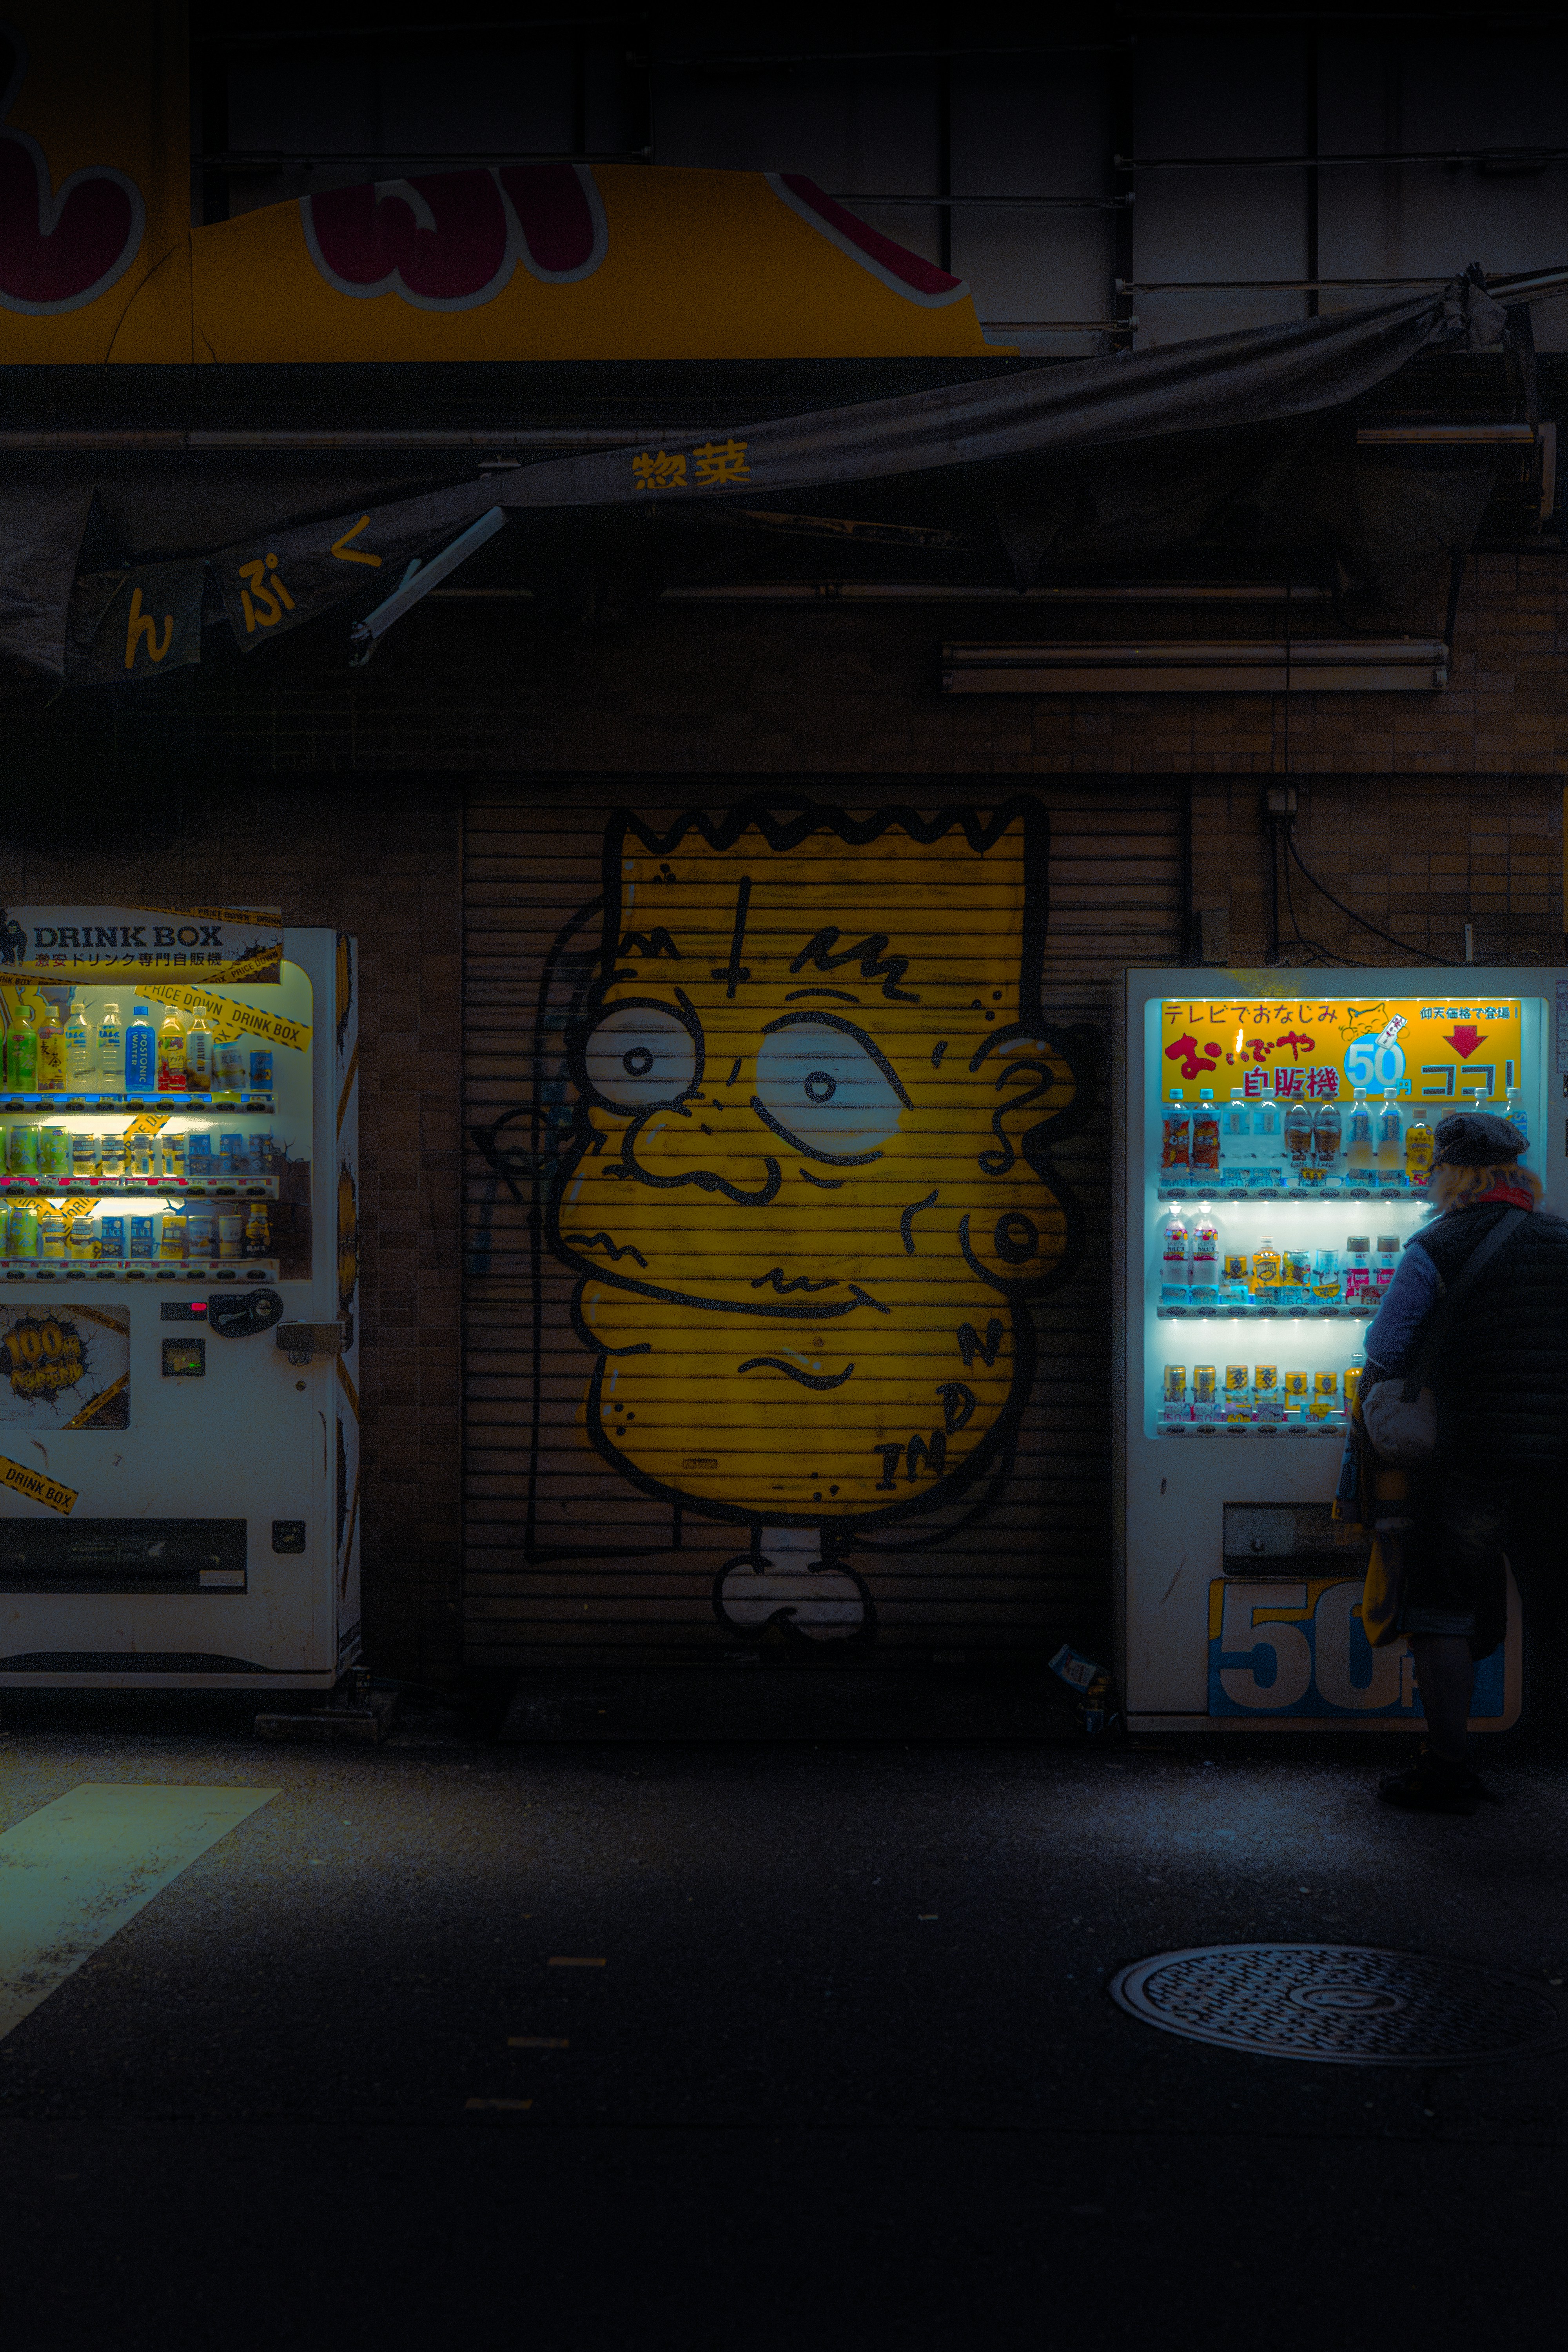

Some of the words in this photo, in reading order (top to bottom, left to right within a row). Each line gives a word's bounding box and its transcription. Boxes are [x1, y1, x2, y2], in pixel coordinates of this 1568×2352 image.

[632, 439, 751, 490] 惣菜
[34, 927, 147, 947] DRINK
[153, 926, 223, 947] BOX
[36, 953, 222, 967] 激安ドリンク専門自販機
[231, 963, 254, 978] PRICE
[255, 951, 278, 967] DOWN
[184, 993, 223, 1016] DOWN
[232, 1009, 272, 1032] DRINK
[274, 1024, 300, 1042] BOX
[1165, 1005, 1338, 1025] テレビでおなじみ
[1165, 1031, 1316, 1080] おいでや
[1243, 1065, 1340, 1098] 自販機
[6, 1468, 45, 1494] DRINK
[46, 1487, 72, 1508] BOX
[1219, 1581, 1413, 1710] 50
